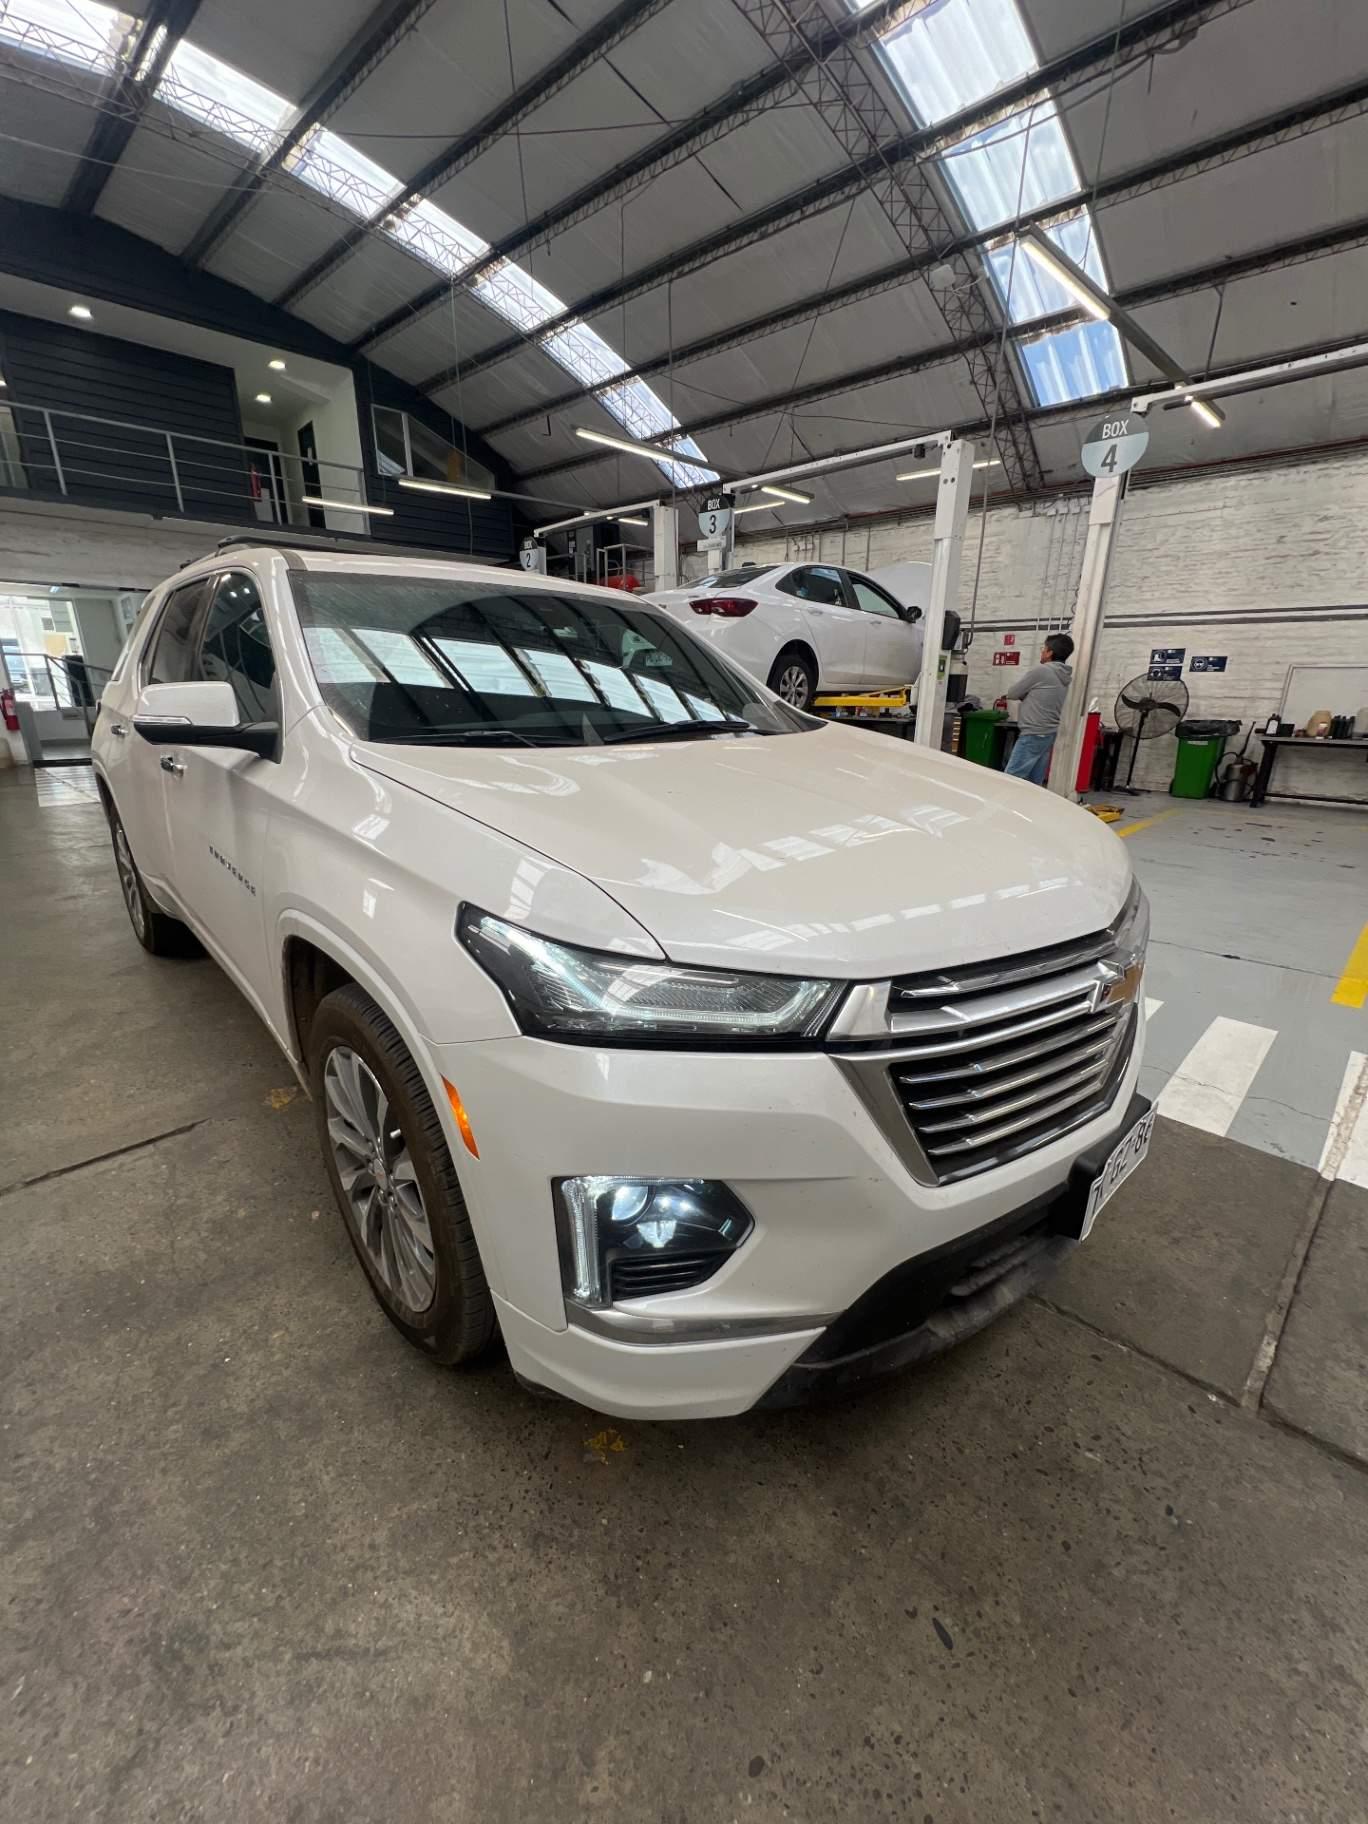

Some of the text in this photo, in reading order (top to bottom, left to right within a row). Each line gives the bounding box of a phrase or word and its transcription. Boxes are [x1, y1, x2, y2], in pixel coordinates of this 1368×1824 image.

[1102, 419, 1129, 439] BOX
[1101, 443, 1118, 473] 4
[707, 498, 720, 511] BOX
[709, 514, 716, 534] 3
[526, 552, 532, 568] 2
